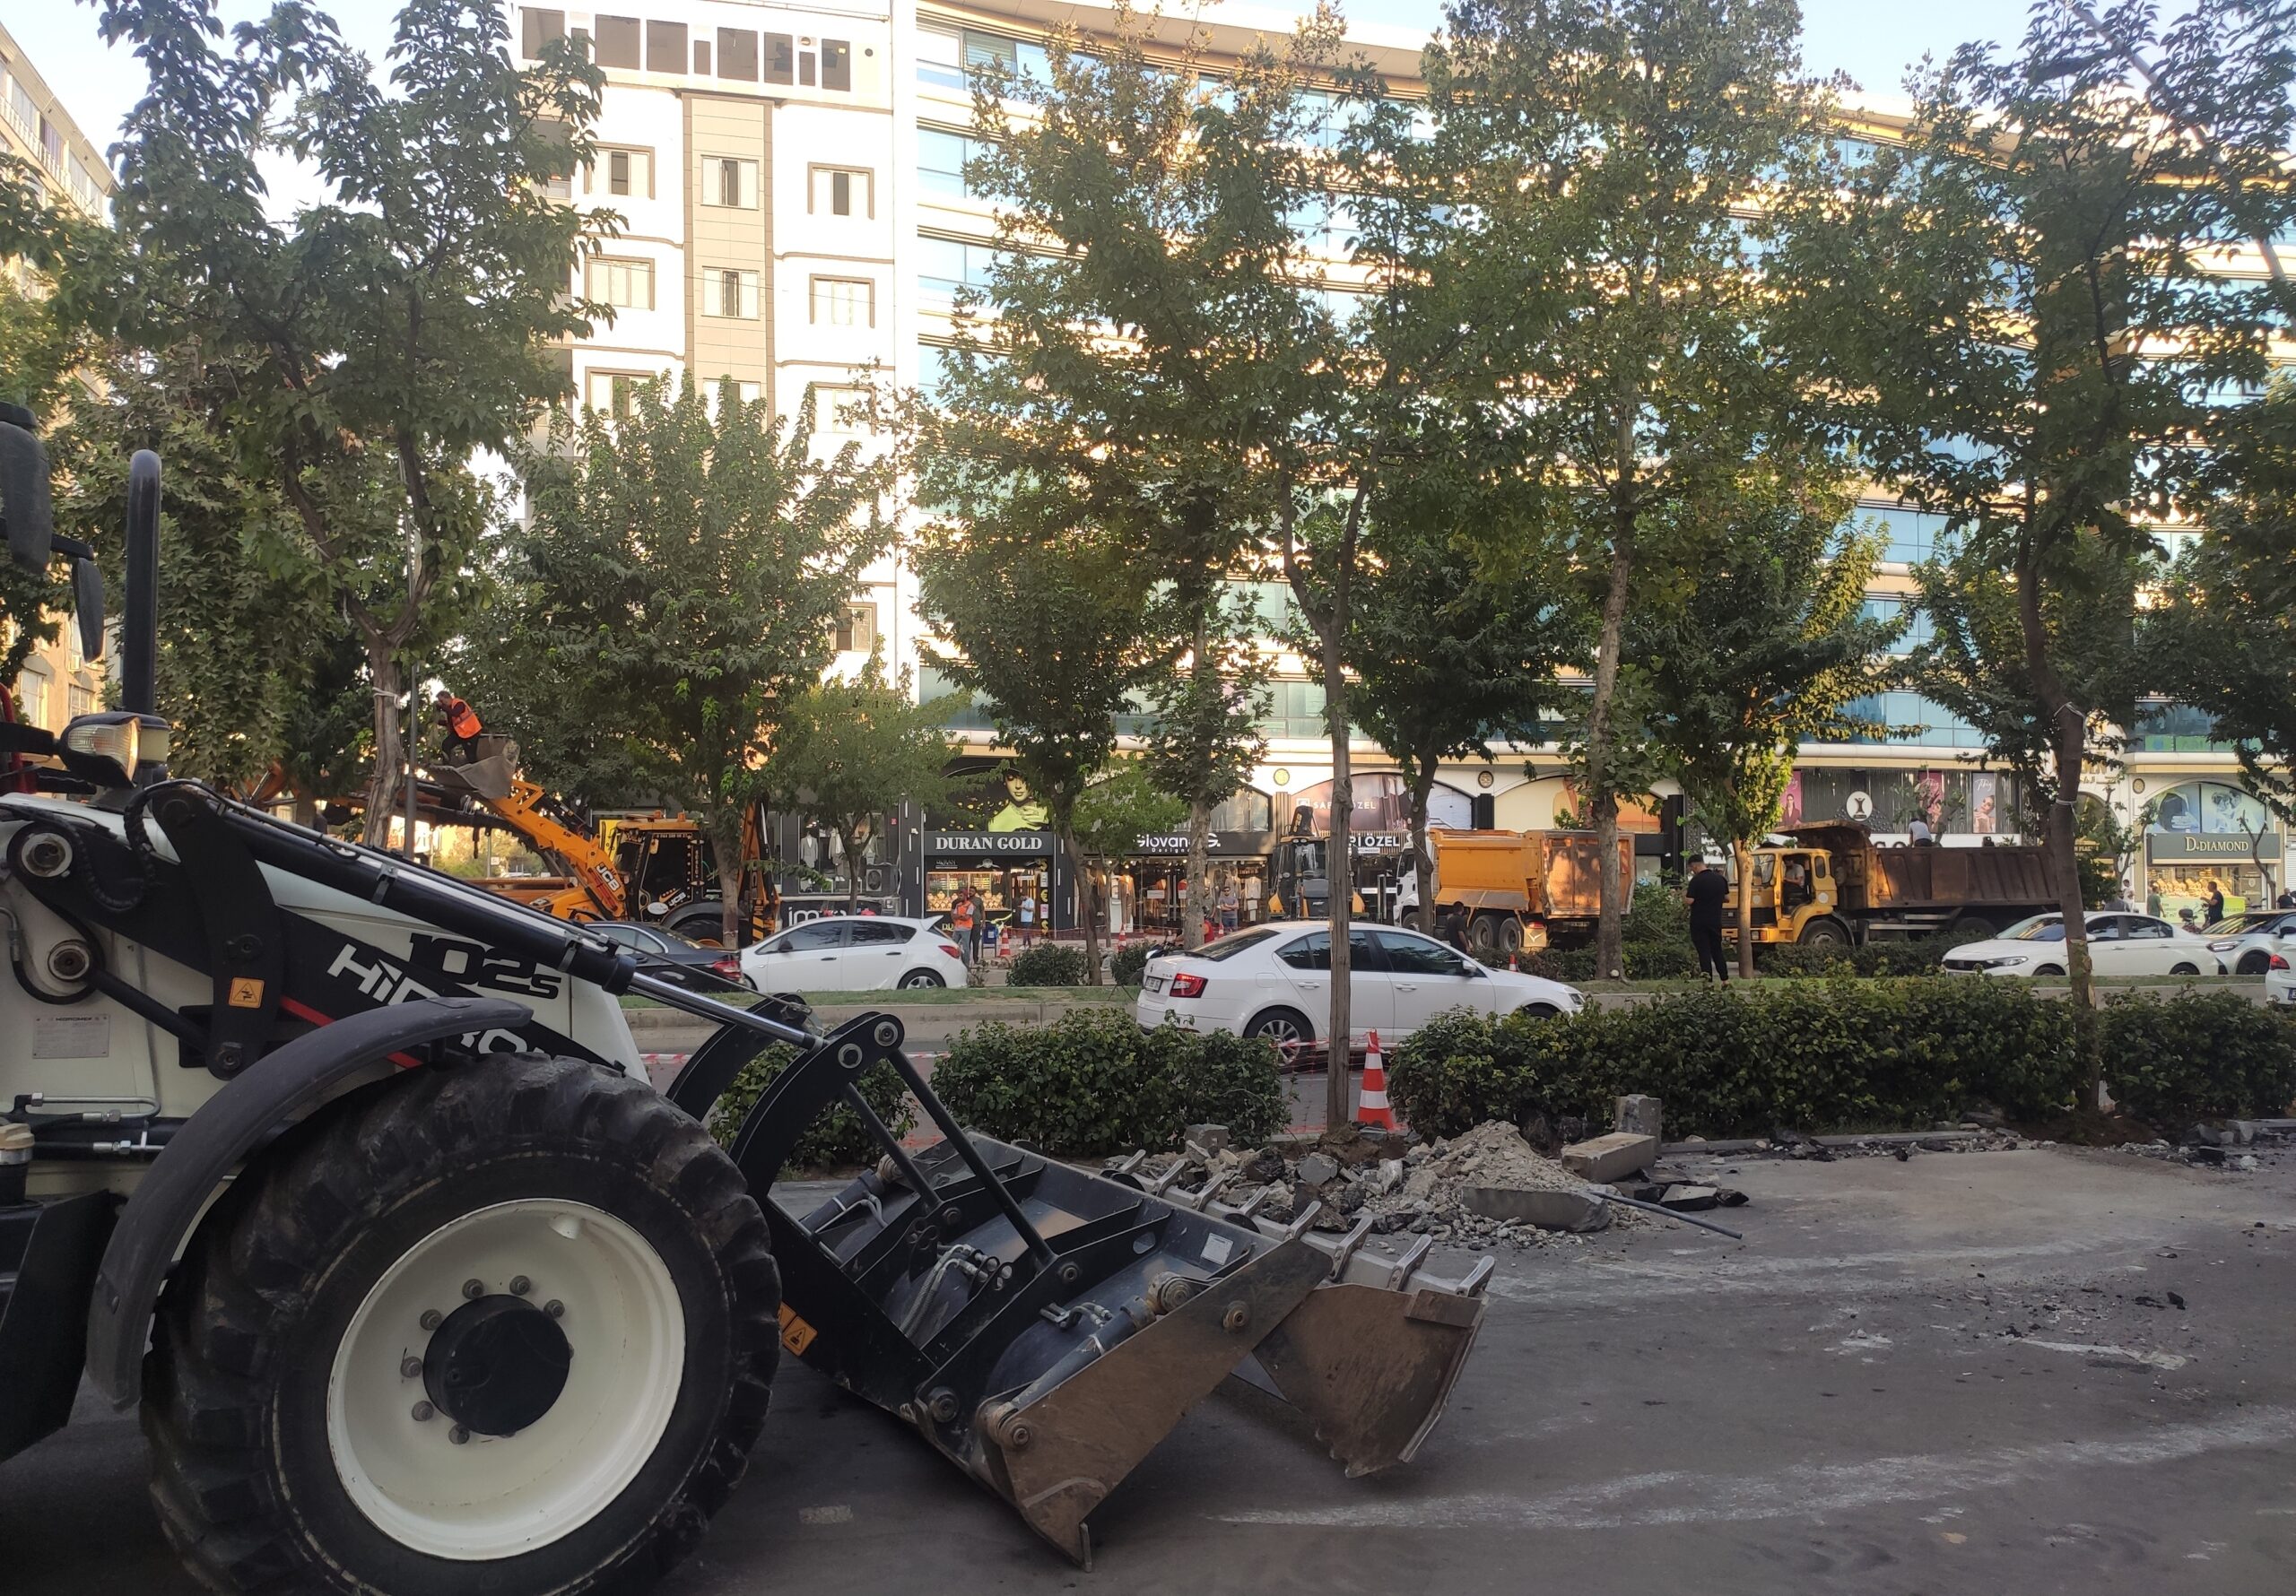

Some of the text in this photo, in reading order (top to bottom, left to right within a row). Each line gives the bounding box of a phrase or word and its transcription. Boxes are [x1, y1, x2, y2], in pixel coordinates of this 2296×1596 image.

[935, 837, 1042, 850] DURAN GOLD
[1133, 833, 1191, 847] Giovan
[1364, 833, 1400, 847] ÖZEL
[596, 863, 620, 891] JCB
[668, 891, 687, 906] JCB
